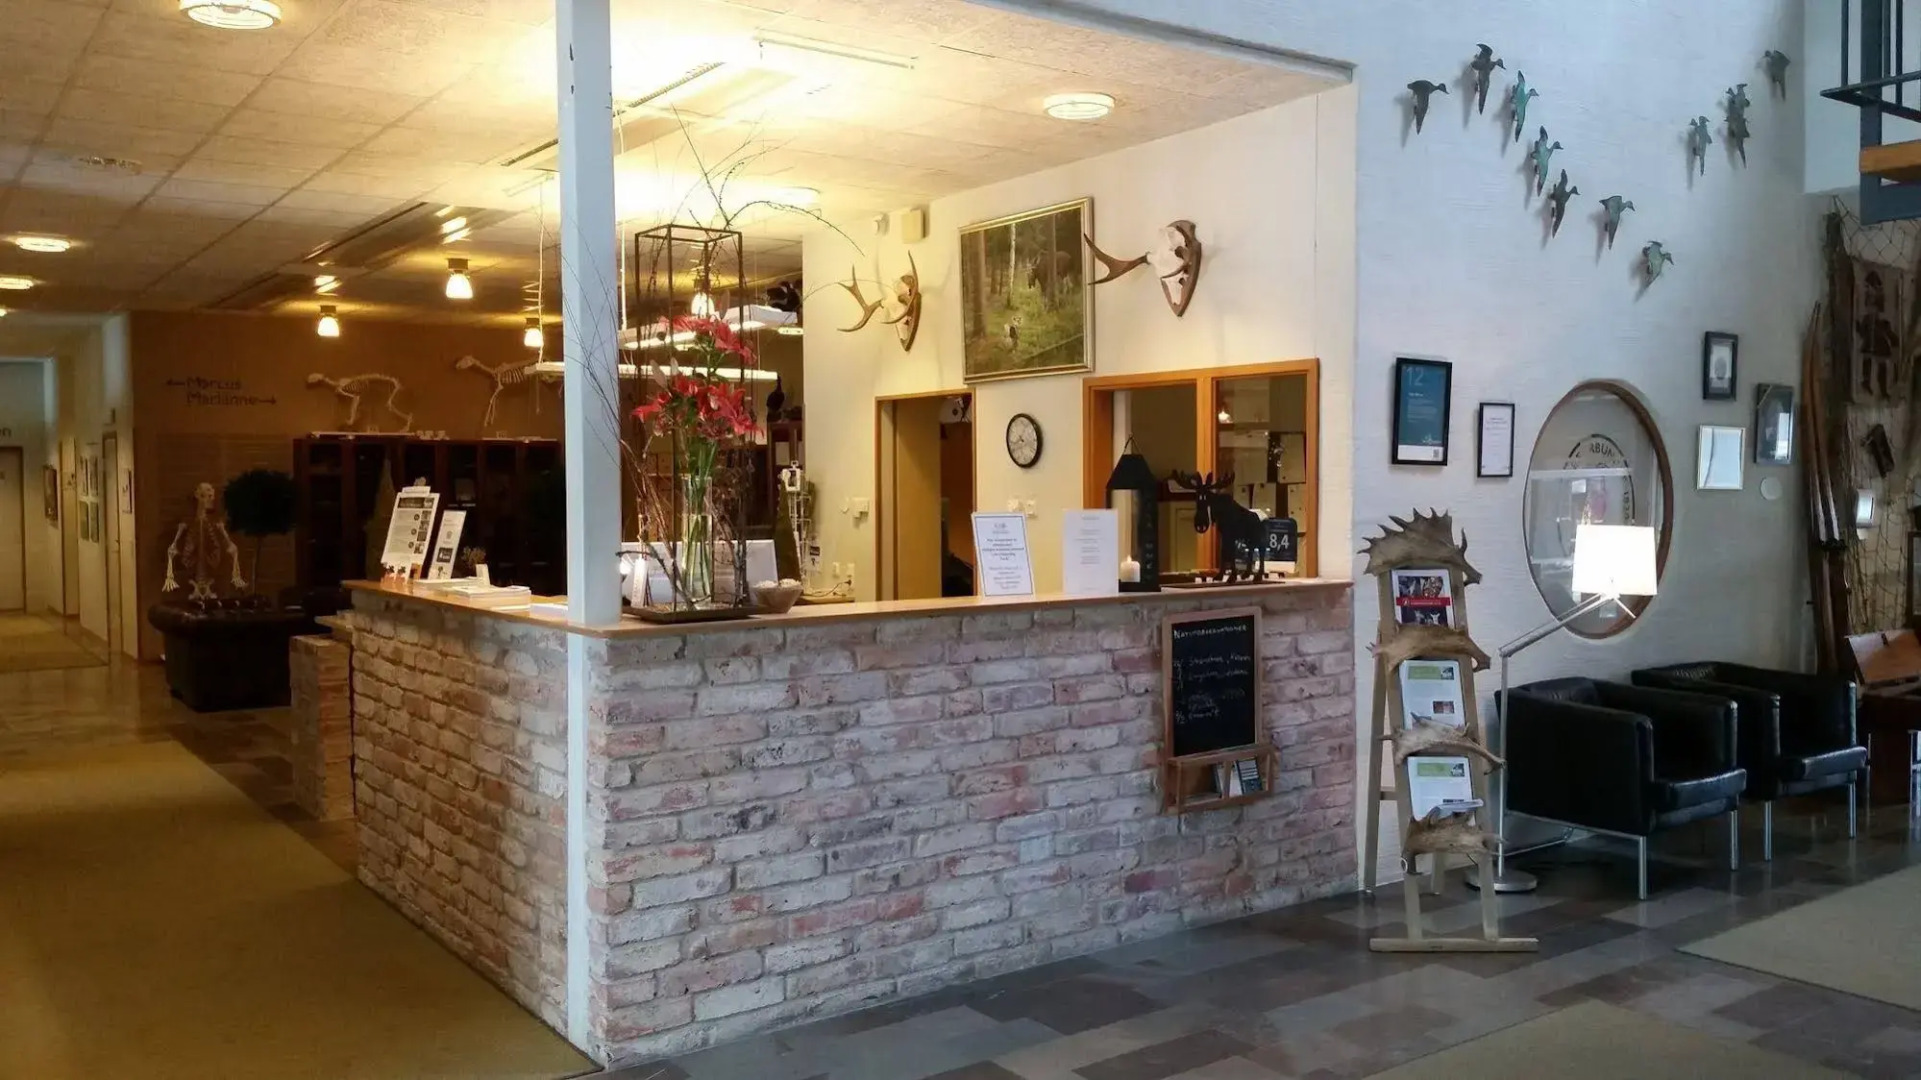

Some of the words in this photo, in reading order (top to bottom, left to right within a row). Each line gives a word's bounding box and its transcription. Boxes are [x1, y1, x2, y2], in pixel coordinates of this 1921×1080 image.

[186, 376, 240, 390] Marcus
[1407, 366, 1424, 386] 12
[1269, 533, 1290, 551] 8,4
